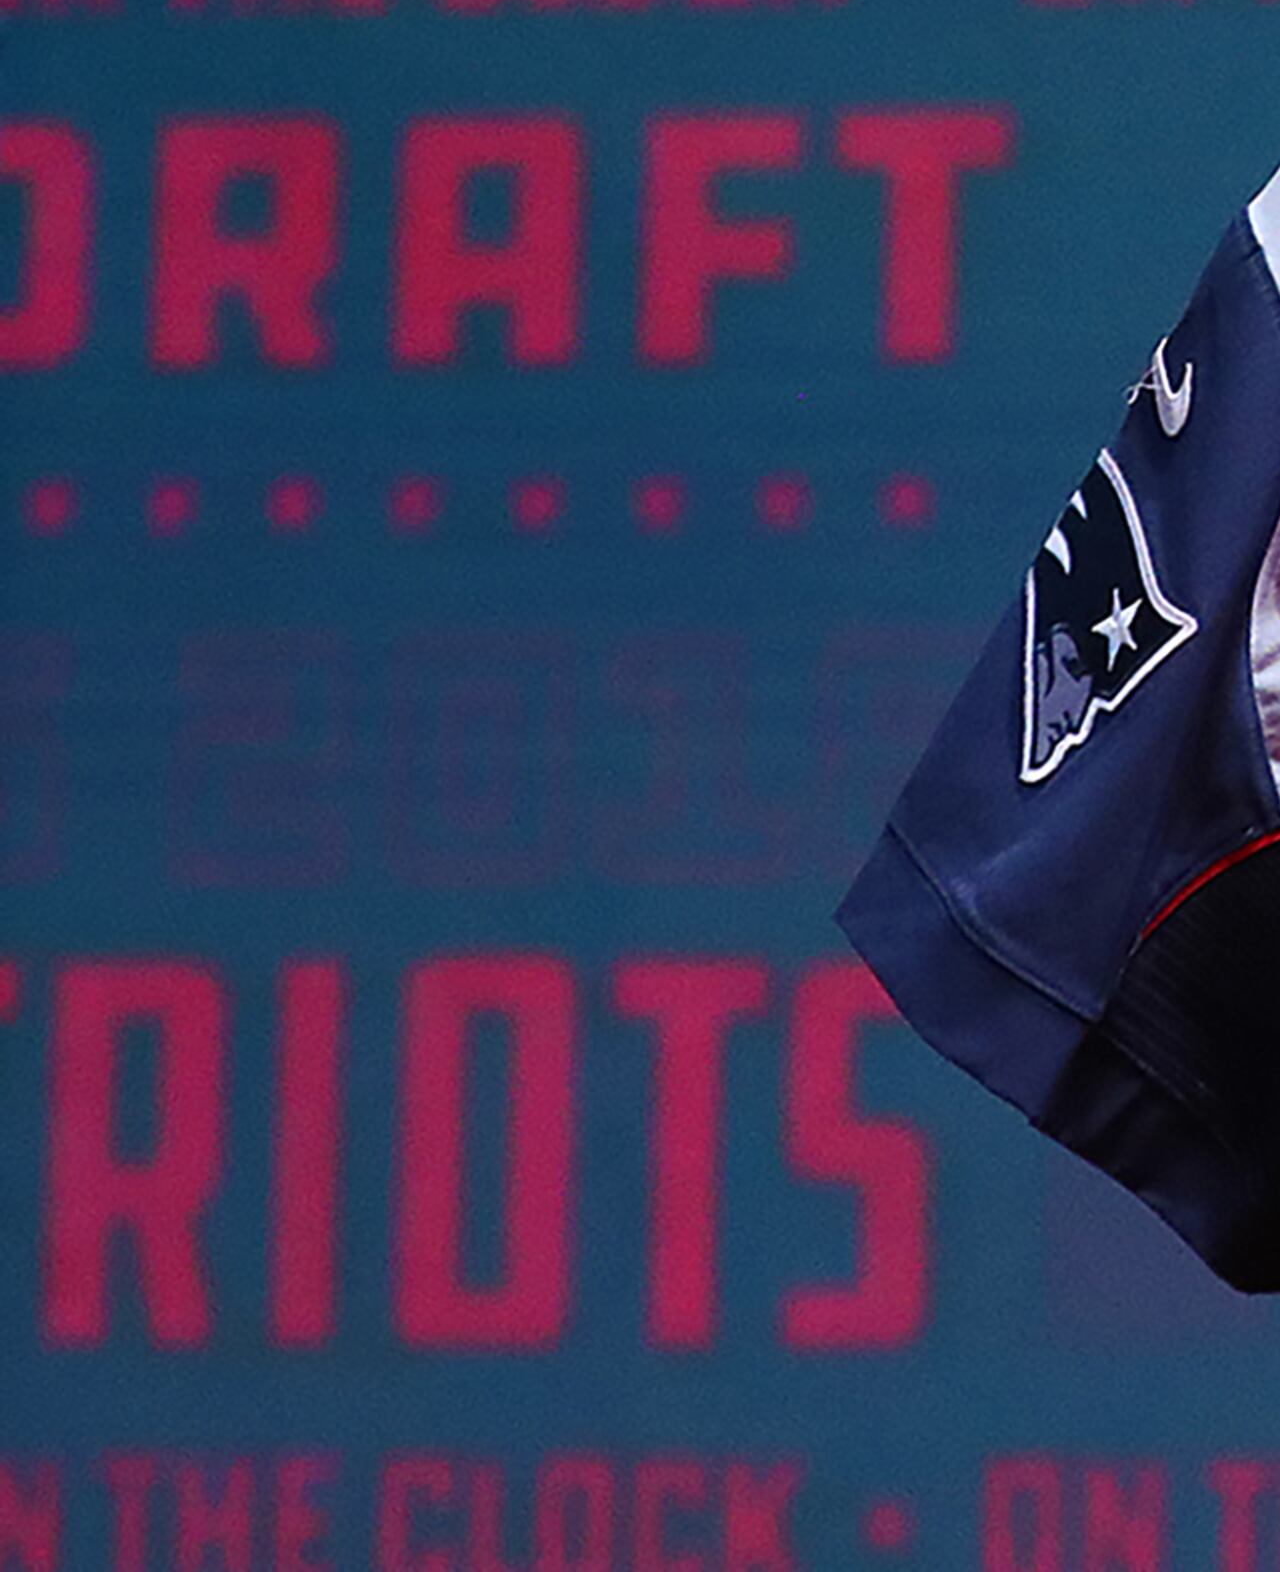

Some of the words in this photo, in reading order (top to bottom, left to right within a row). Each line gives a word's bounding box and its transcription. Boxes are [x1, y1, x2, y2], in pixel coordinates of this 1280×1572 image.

[0, 946, 940, 1356] RIOTS
[98, 1446, 340, 1572] THE
[376, 1446, 803, 1572] CLOCK
[983, 1446, 1172, 1572] ON
